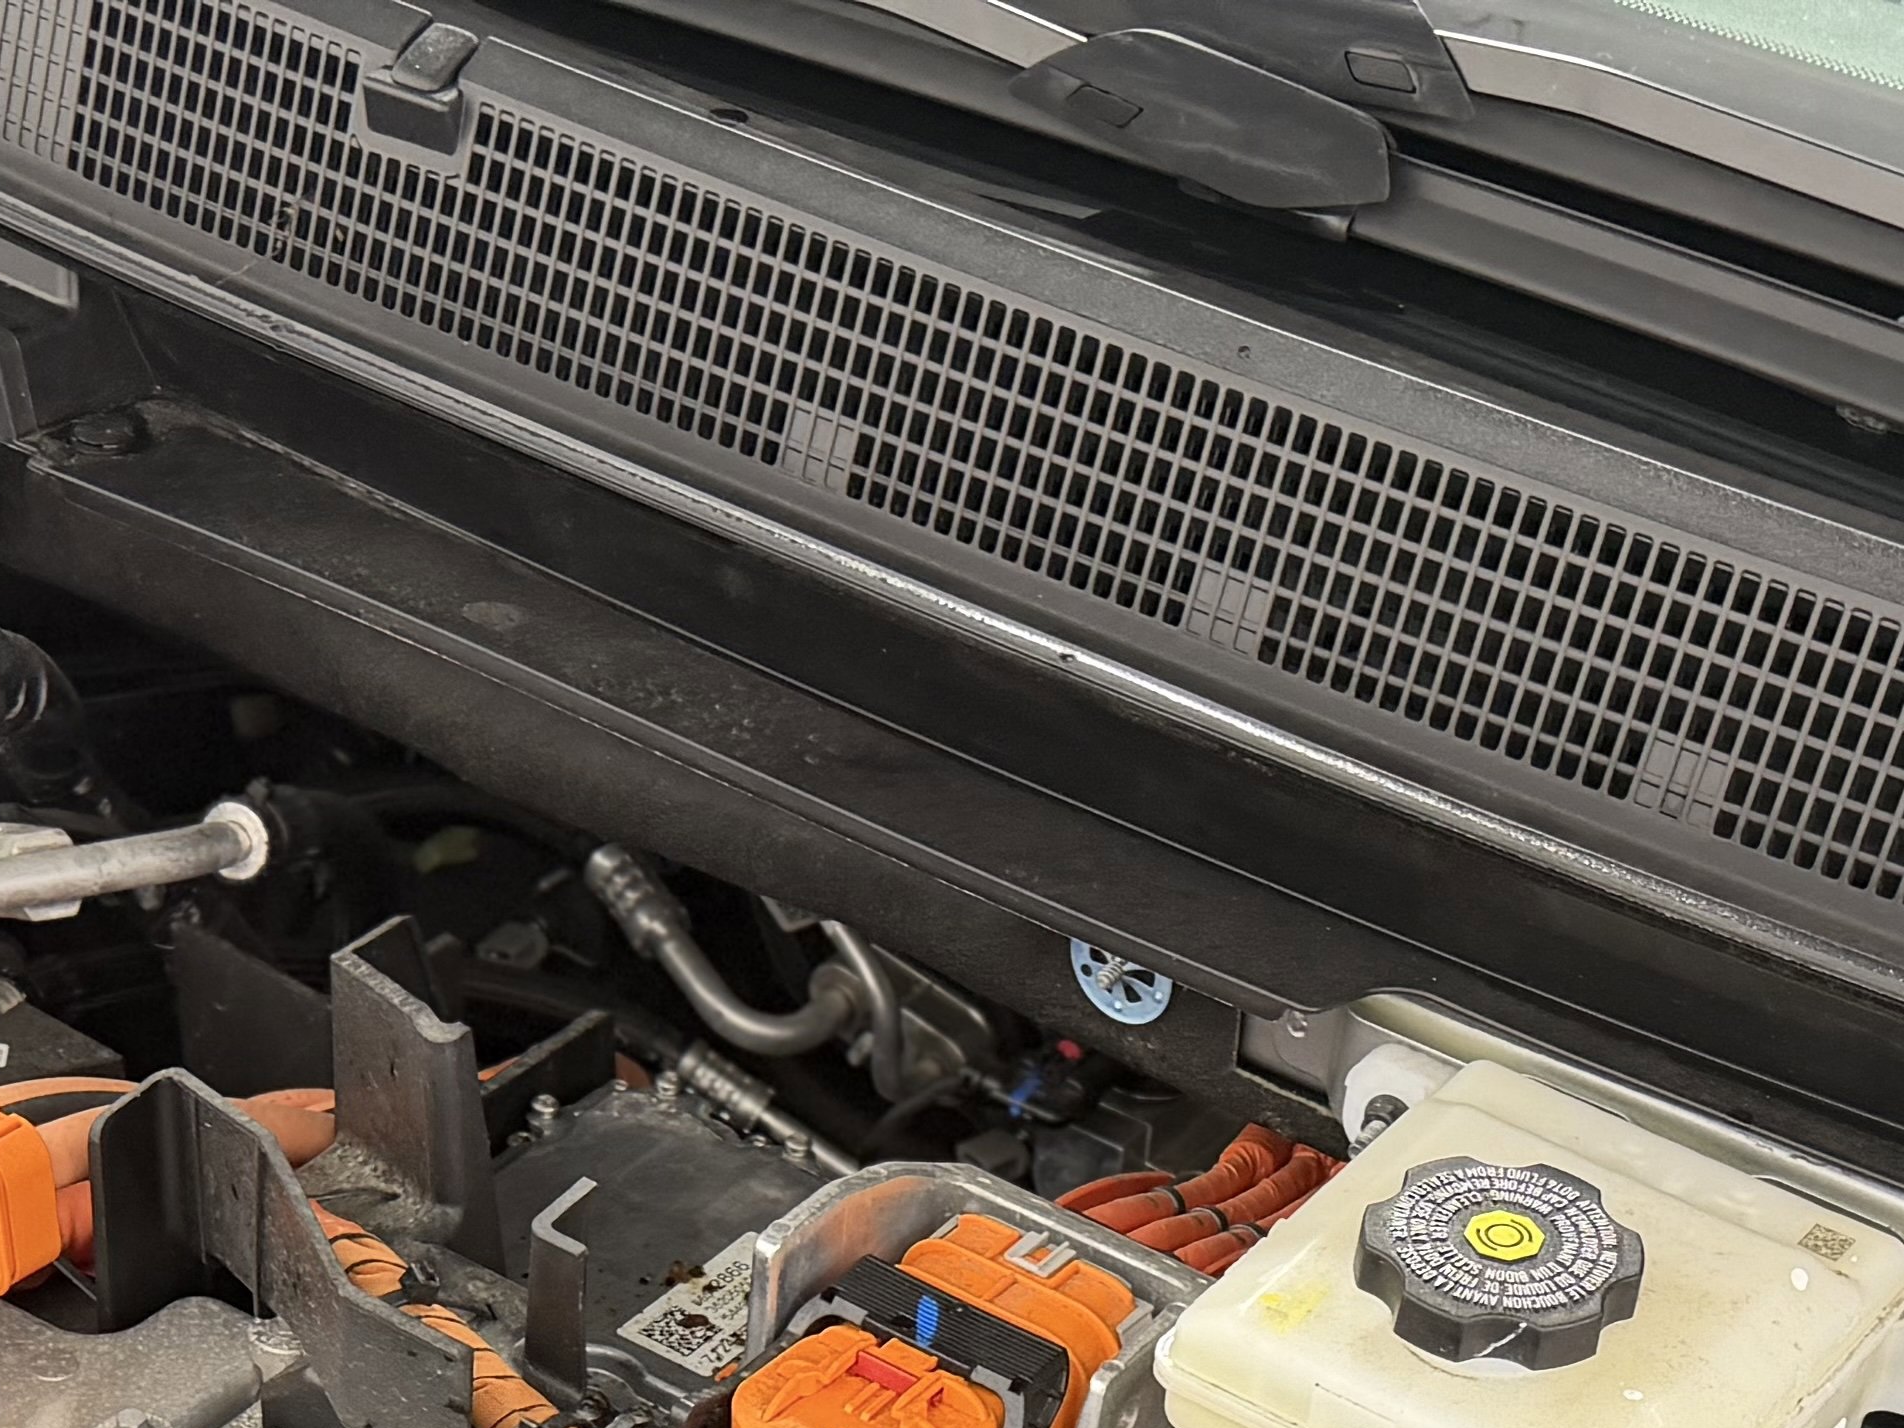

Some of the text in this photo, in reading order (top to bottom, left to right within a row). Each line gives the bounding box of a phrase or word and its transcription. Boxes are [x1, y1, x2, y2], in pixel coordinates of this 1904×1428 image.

[1463, 1166, 1503, 1177] FROM
[1506, 1168, 1547, 1185] FLUID
[1409, 1167, 1457, 1196] SEALED
[1491, 1177, 1544, 1197] BEFORE
[1541, 1189, 1569, 1208] CAP
[1412, 1199, 1435, 1218] USE
[1429, 1274, 1455, 1291] LA
[1437, 1262, 1478, 1288] FREIN
[1481, 1267, 1530, 1282] BIDON
[1451, 1284, 1498, 1306] AVANT
[1480, 1279, 1499, 1293] DE
[1502, 1276, 1558, 1297] LIQUIDE
[1563, 1284, 1587, 1300] LE
[1501, 1287, 1570, 1310] BOUCHON
